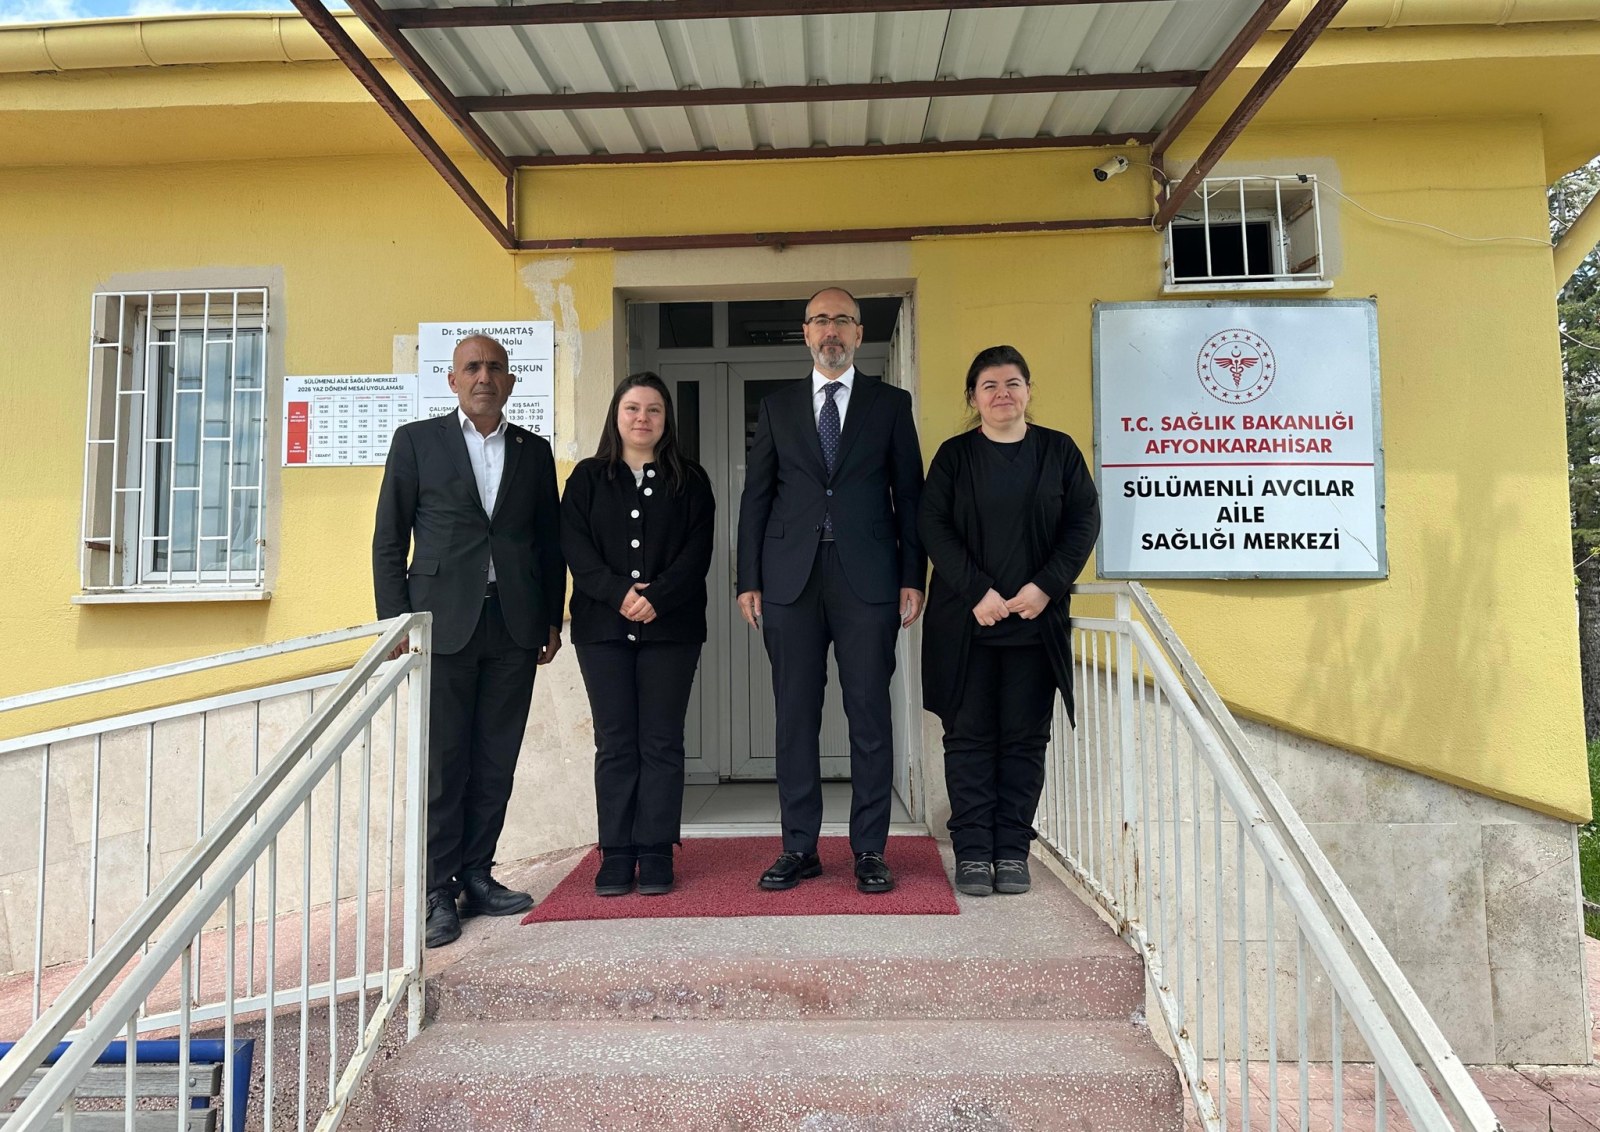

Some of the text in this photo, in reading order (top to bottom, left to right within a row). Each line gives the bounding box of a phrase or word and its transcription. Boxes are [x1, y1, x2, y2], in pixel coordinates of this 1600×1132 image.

[456, 328, 480, 336] Seda
[481, 327, 534, 337] KUMARTAŞ
[502, 338, 522, 346] Nolu
[508, 365, 543, 375] OŞKUN
[528, 424, 541, 433] 75
[1120, 410, 1354, 432] T.C. SAĞLIK BAKANLIĞI
[1144, 433, 1333, 454] AFYONKARAHİSAR
[1123, 475, 1354, 498] SÜLÜMENLİ AVCILAR
[1216, 501, 1265, 524] AİLE
[1141, 527, 1340, 550] SAĞLIĞI MERKEZİ
